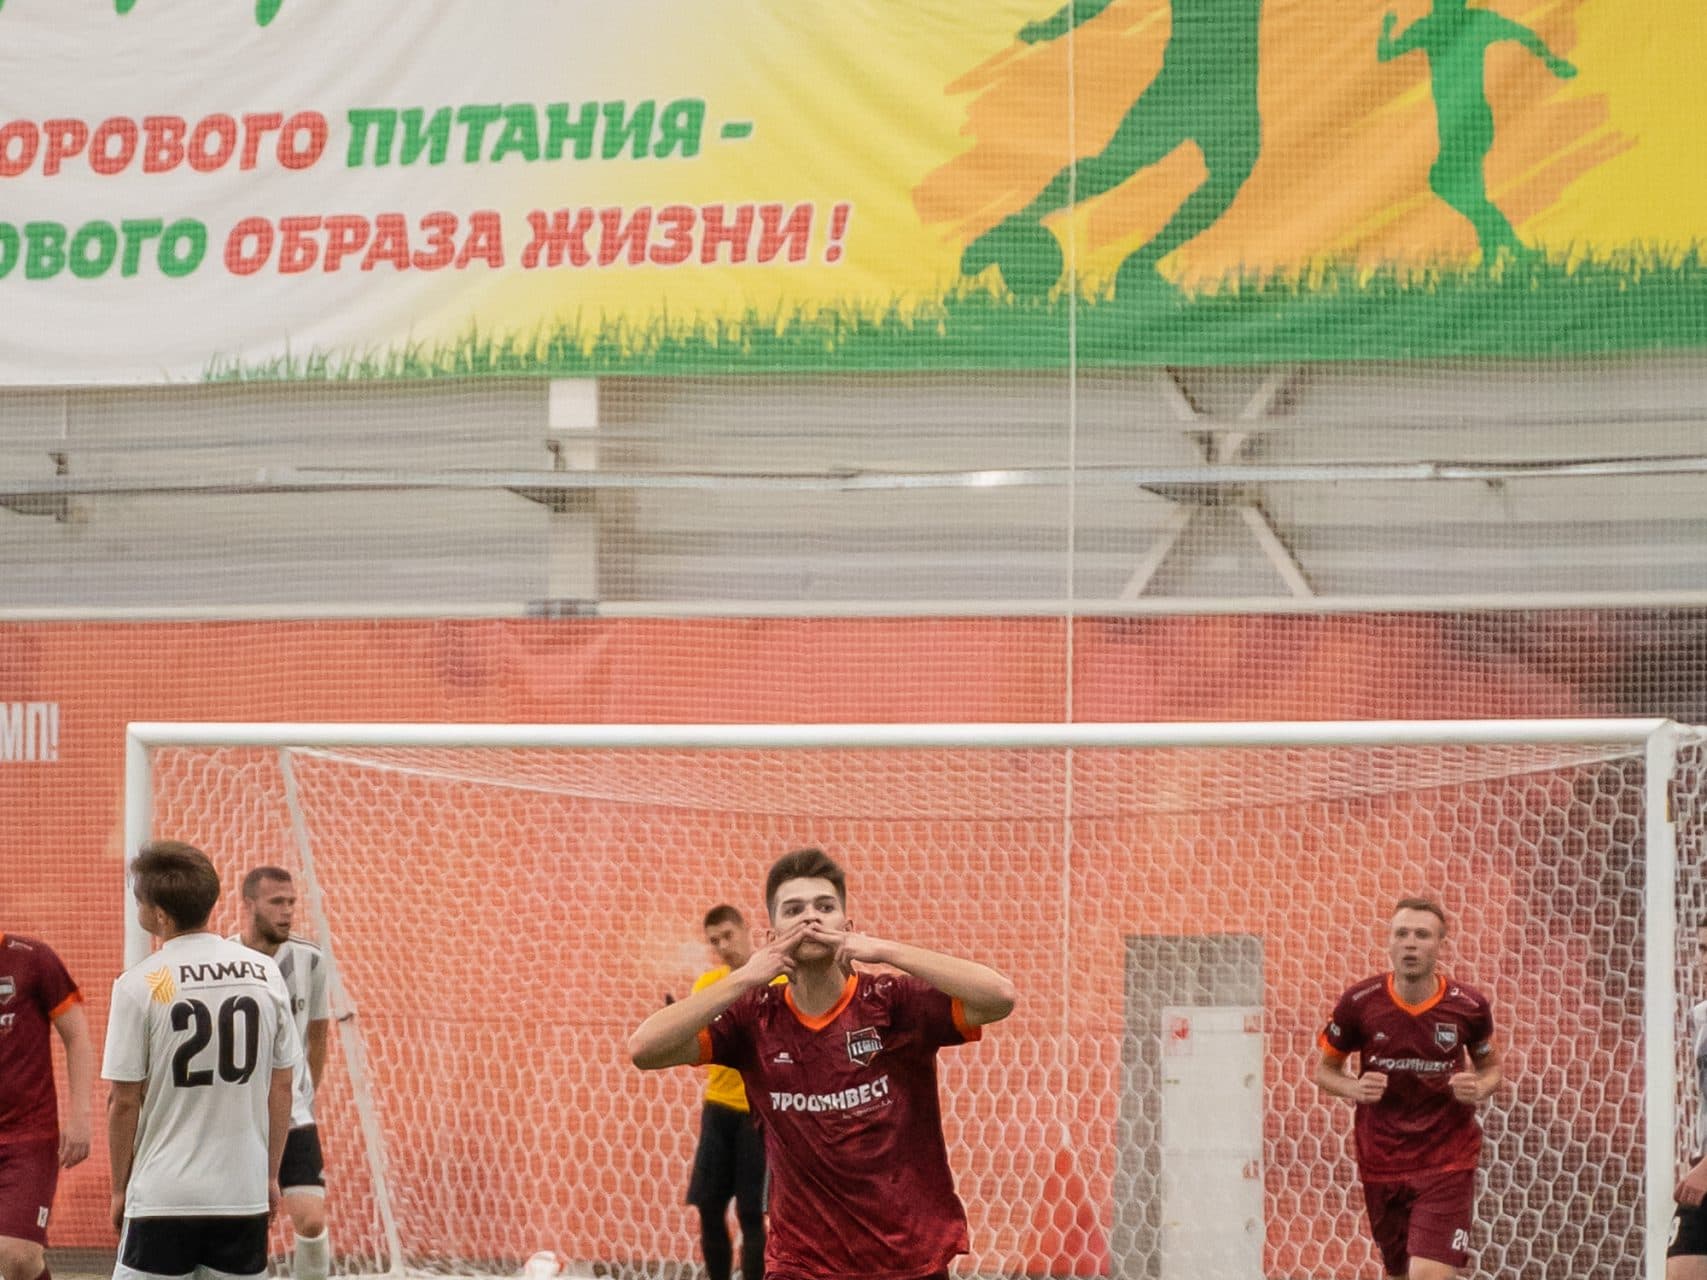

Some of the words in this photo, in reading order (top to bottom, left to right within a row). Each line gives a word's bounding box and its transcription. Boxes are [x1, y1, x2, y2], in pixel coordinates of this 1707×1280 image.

[346, 100, 706, 168] ПИТАНИЯ
[224, 211, 505, 277] ОБРАЗА
[521, 203, 814, 271] ЖИЗНИ
[179, 960, 268, 983] АЛМАЗ
[170, 995, 261, 1088] 20
[769, 1074, 889, 1112] ПРОДИНВЕСТ
